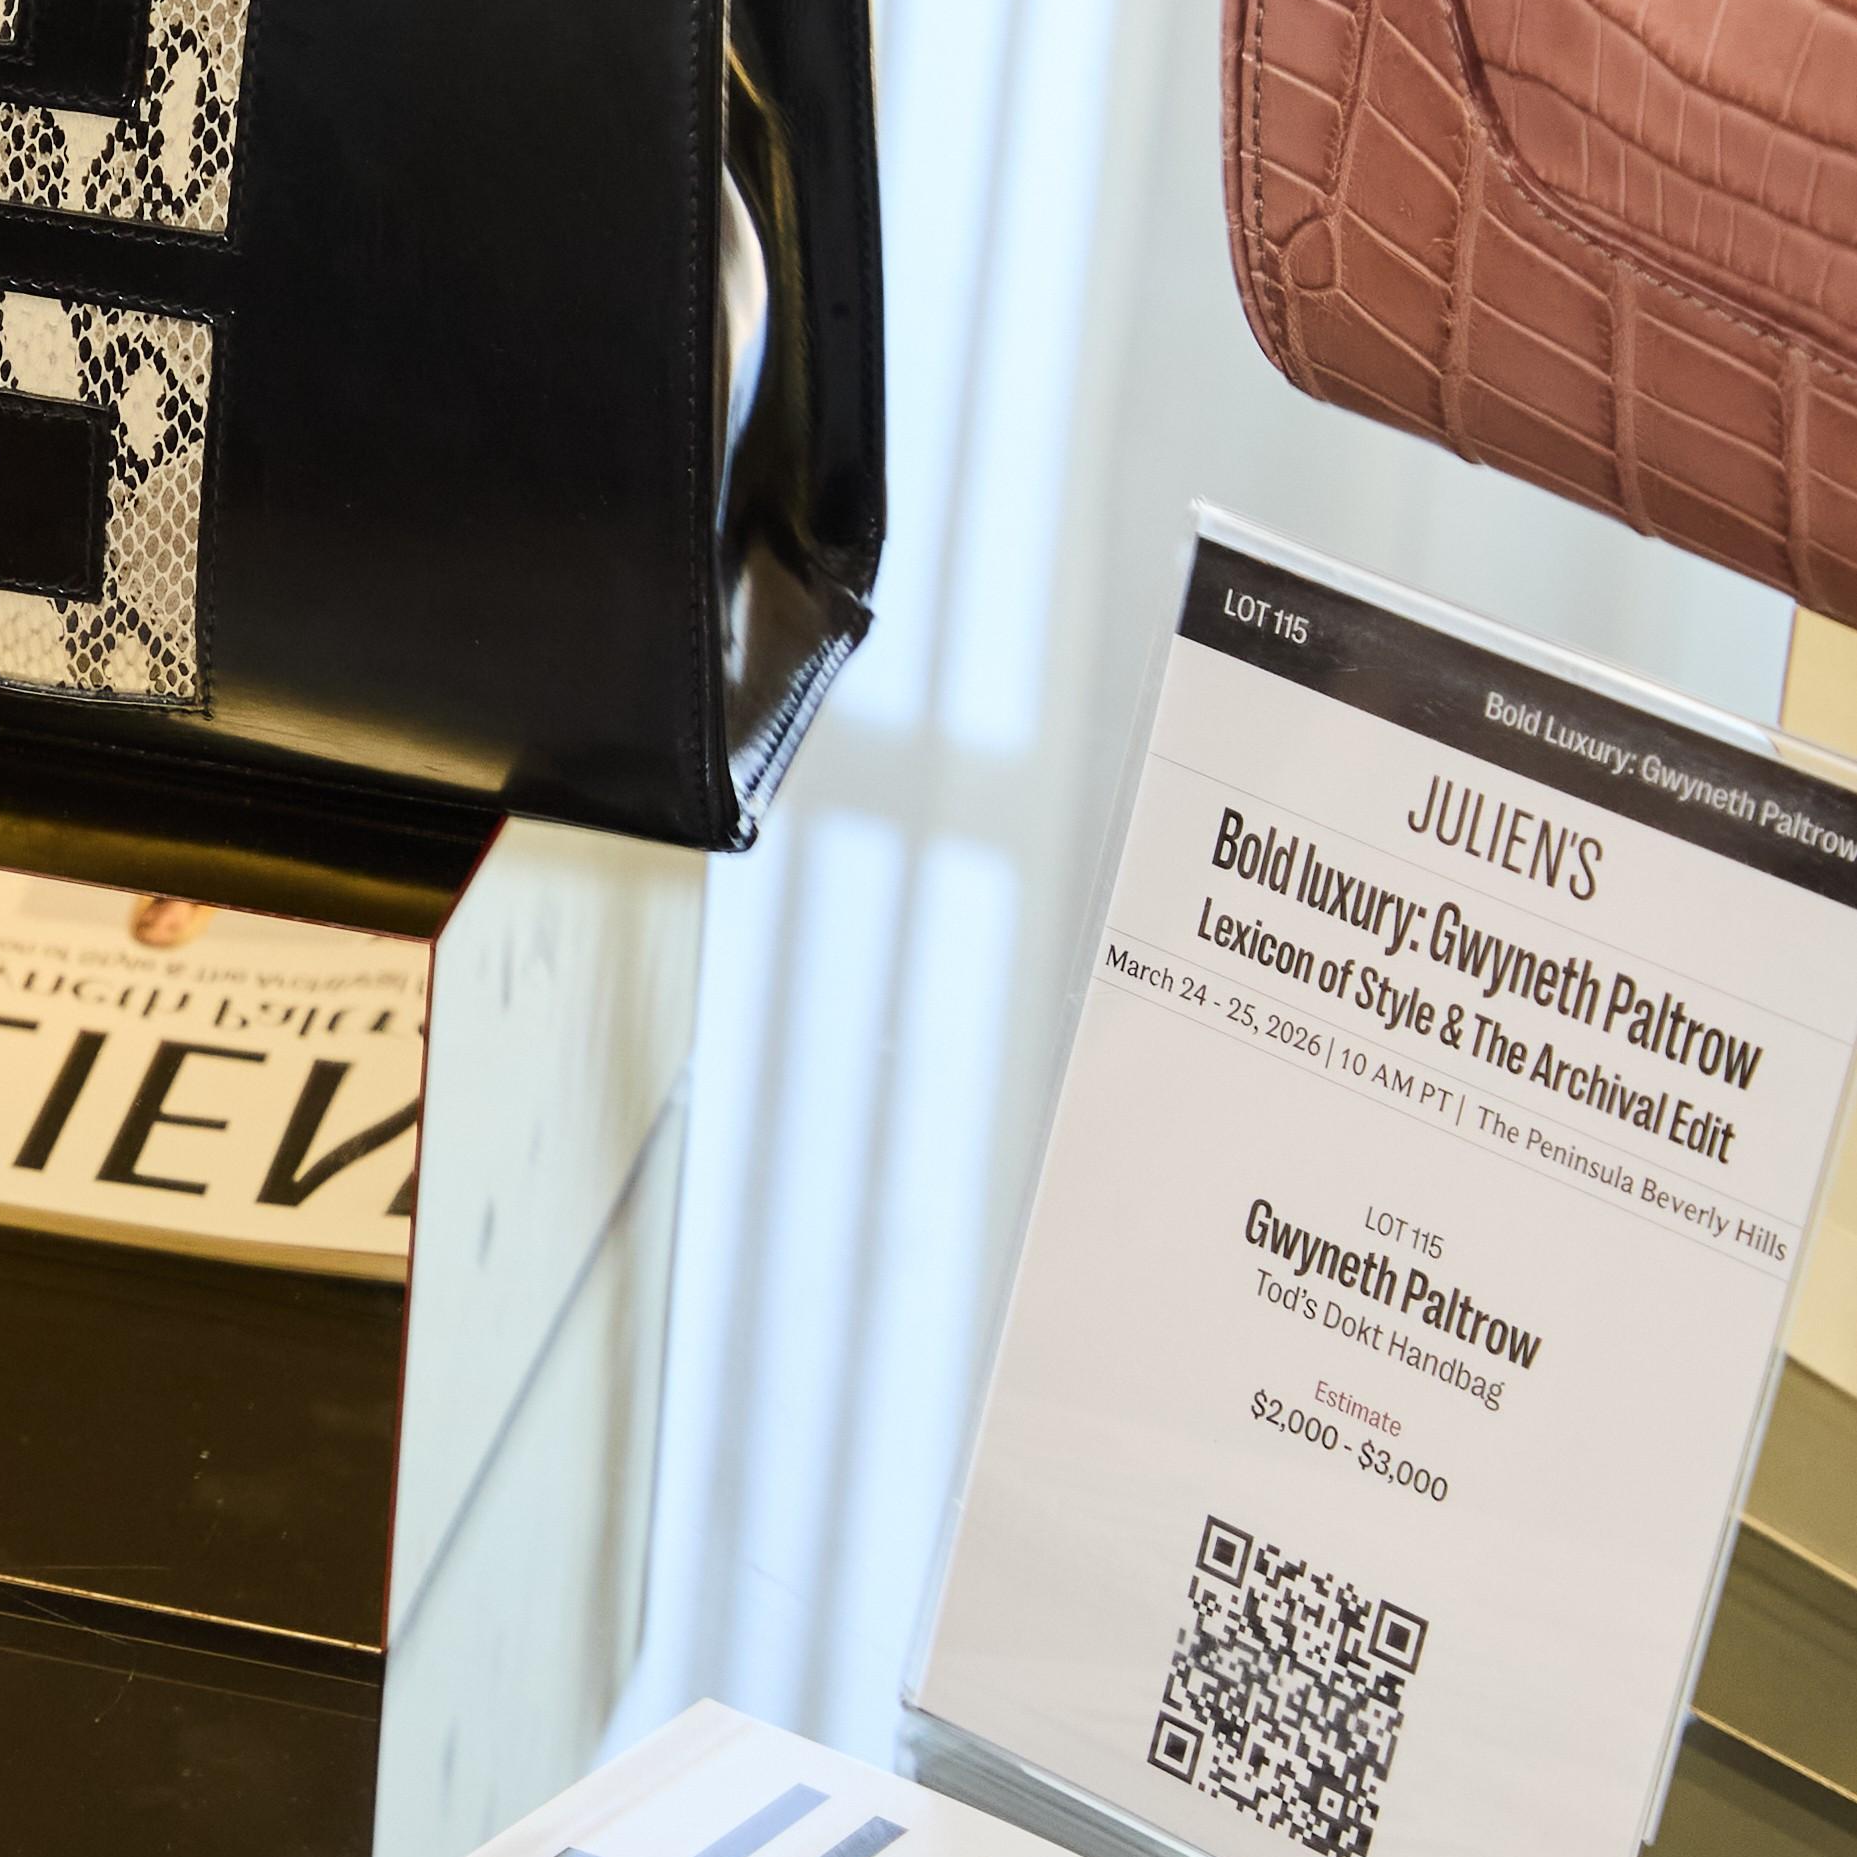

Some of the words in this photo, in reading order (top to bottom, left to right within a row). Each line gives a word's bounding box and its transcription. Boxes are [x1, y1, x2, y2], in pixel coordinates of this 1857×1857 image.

[1224, 588, 1272, 629] LOT
[1274, 608, 1310, 645] 115
[1407, 774, 1604, 901] JULIEN'S
[1484, 691, 1542, 736] Bold
[1544, 714, 1638, 776] Luxury:
[1642, 753, 1758, 822] Gwyneth
[1760, 799, 1857, 863] Paltrow
[1212, 806, 1300, 895] Bold
[1295, 842, 1428, 957] luxury:
[1430, 901, 1602, 1025] Gwyneth
[1602, 972, 1764, 1091] Paltrow
[1197, 896, 1316, 985] Lexicon
[1319, 959, 1355, 999] of
[1355, 965, 1436, 1036] Style
[1440, 1004, 1465, 1050] &
[1471, 1013, 1528, 1075] The
[1530, 1043, 1669, 1136] Archival
[1668, 1099, 1736, 1165] Edit
[1105, 944, 1174, 993] March
[1179, 976, 1207, 1007] 24
[1227, 997, 1259, 1035] 25,
[1265, 1014, 1324, 1056] 2026
[1341, 1048, 1368, 1076] 10
[1370, 1064, 1415, 1098] AM
[1419, 1081, 1454, 1113] PT
[1477, 1105, 1520, 1144] The
[1526, 1128, 1633, 1194] Peninsula
[1640, 1177, 1730, 1238] Beverly
[1735, 1219, 1789, 1262] Hills
[1244, 1198, 1398, 1307] Gwyneth
[1400, 1267, 1543, 1370] Paltrow
[1365, 1205, 1408, 1243] LOT
[1412, 1227, 1445, 1260] 115
[1256, 1268, 1318, 1320] Tod's
[1323, 1301, 1384, 1352] Dokt
[1387, 1330, 1506, 1412] Handbag
[1314, 1380, 1402, 1437] Estimate
[1250, 1389, 1339, 1451] $2,000
[1357, 1439, 1449, 1503] $3,000
